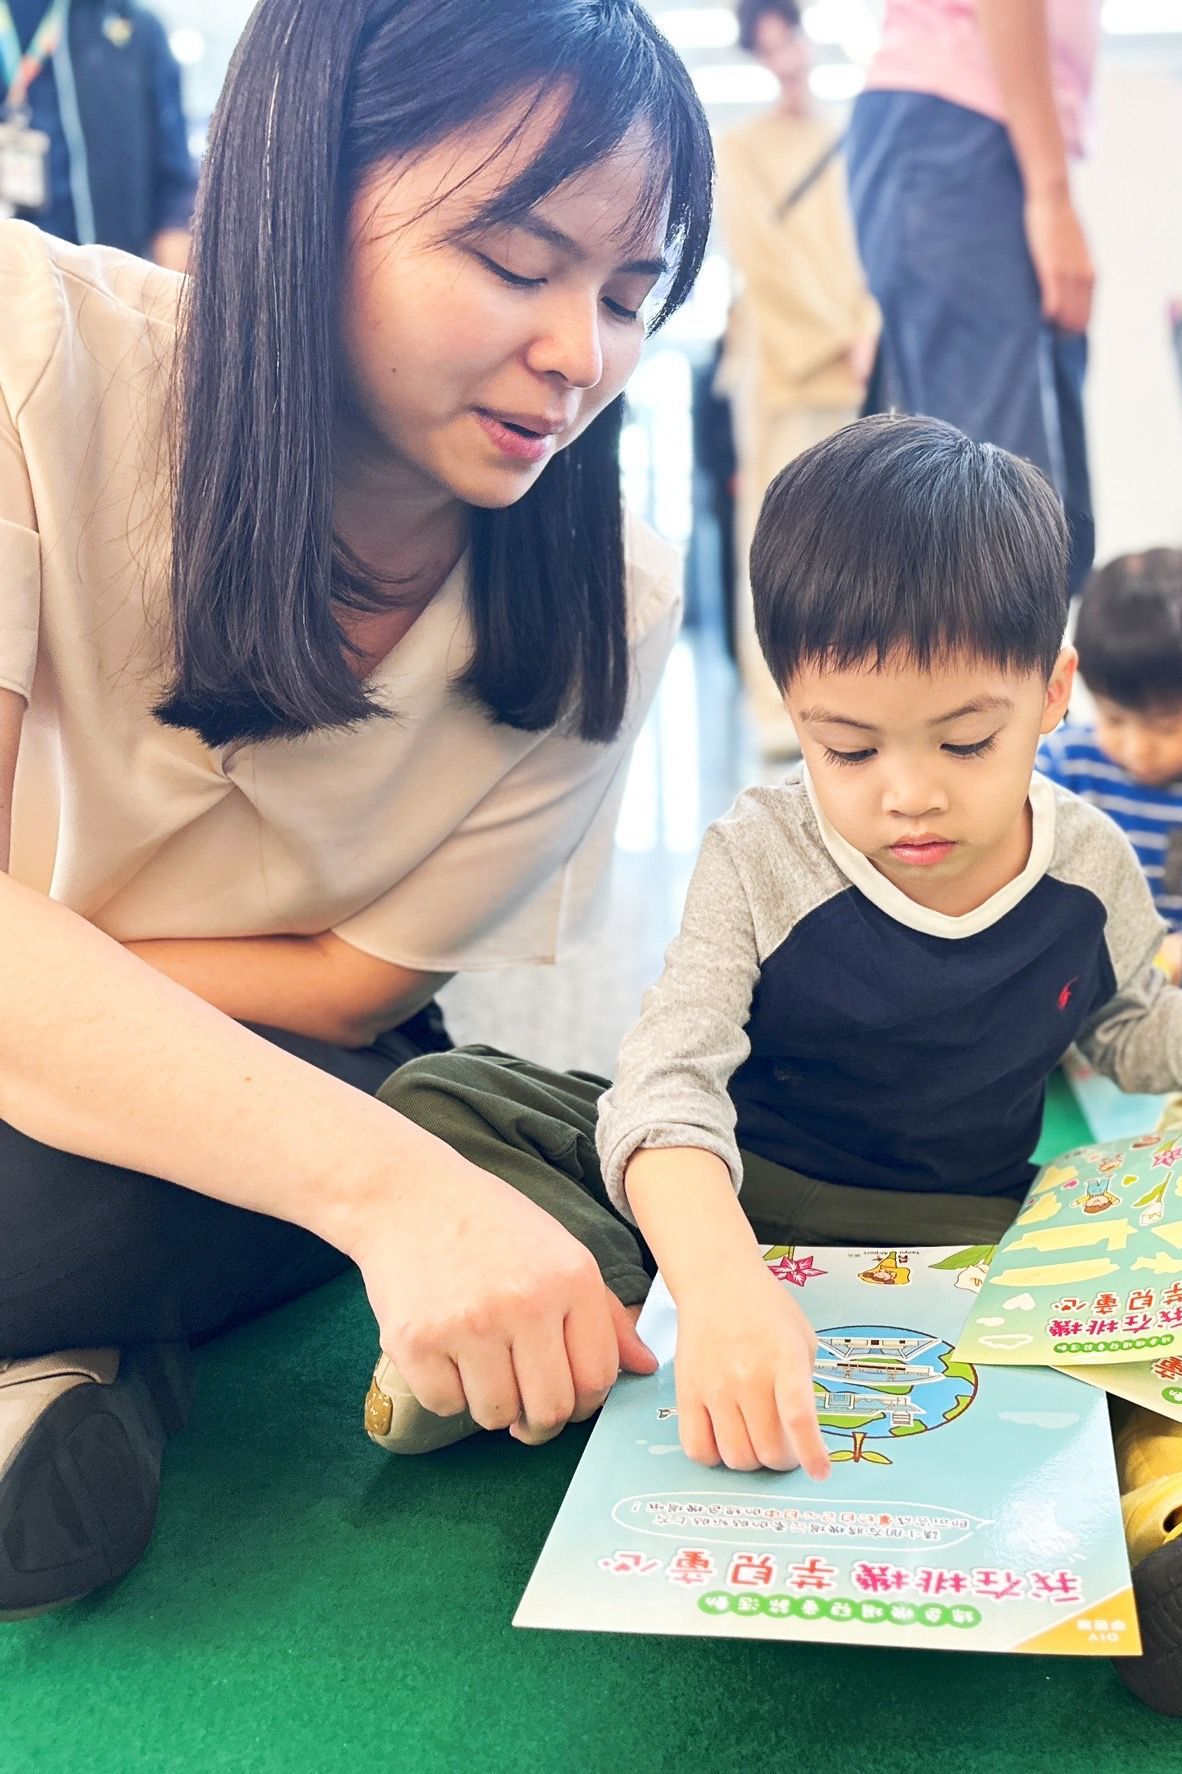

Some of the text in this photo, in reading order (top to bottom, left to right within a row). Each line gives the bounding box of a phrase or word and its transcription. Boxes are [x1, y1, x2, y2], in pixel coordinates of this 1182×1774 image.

[602, 1551, 1080, 1603] 我在桃機 芋兒童心
[1087, 1632, 1120, 1643] DIY
